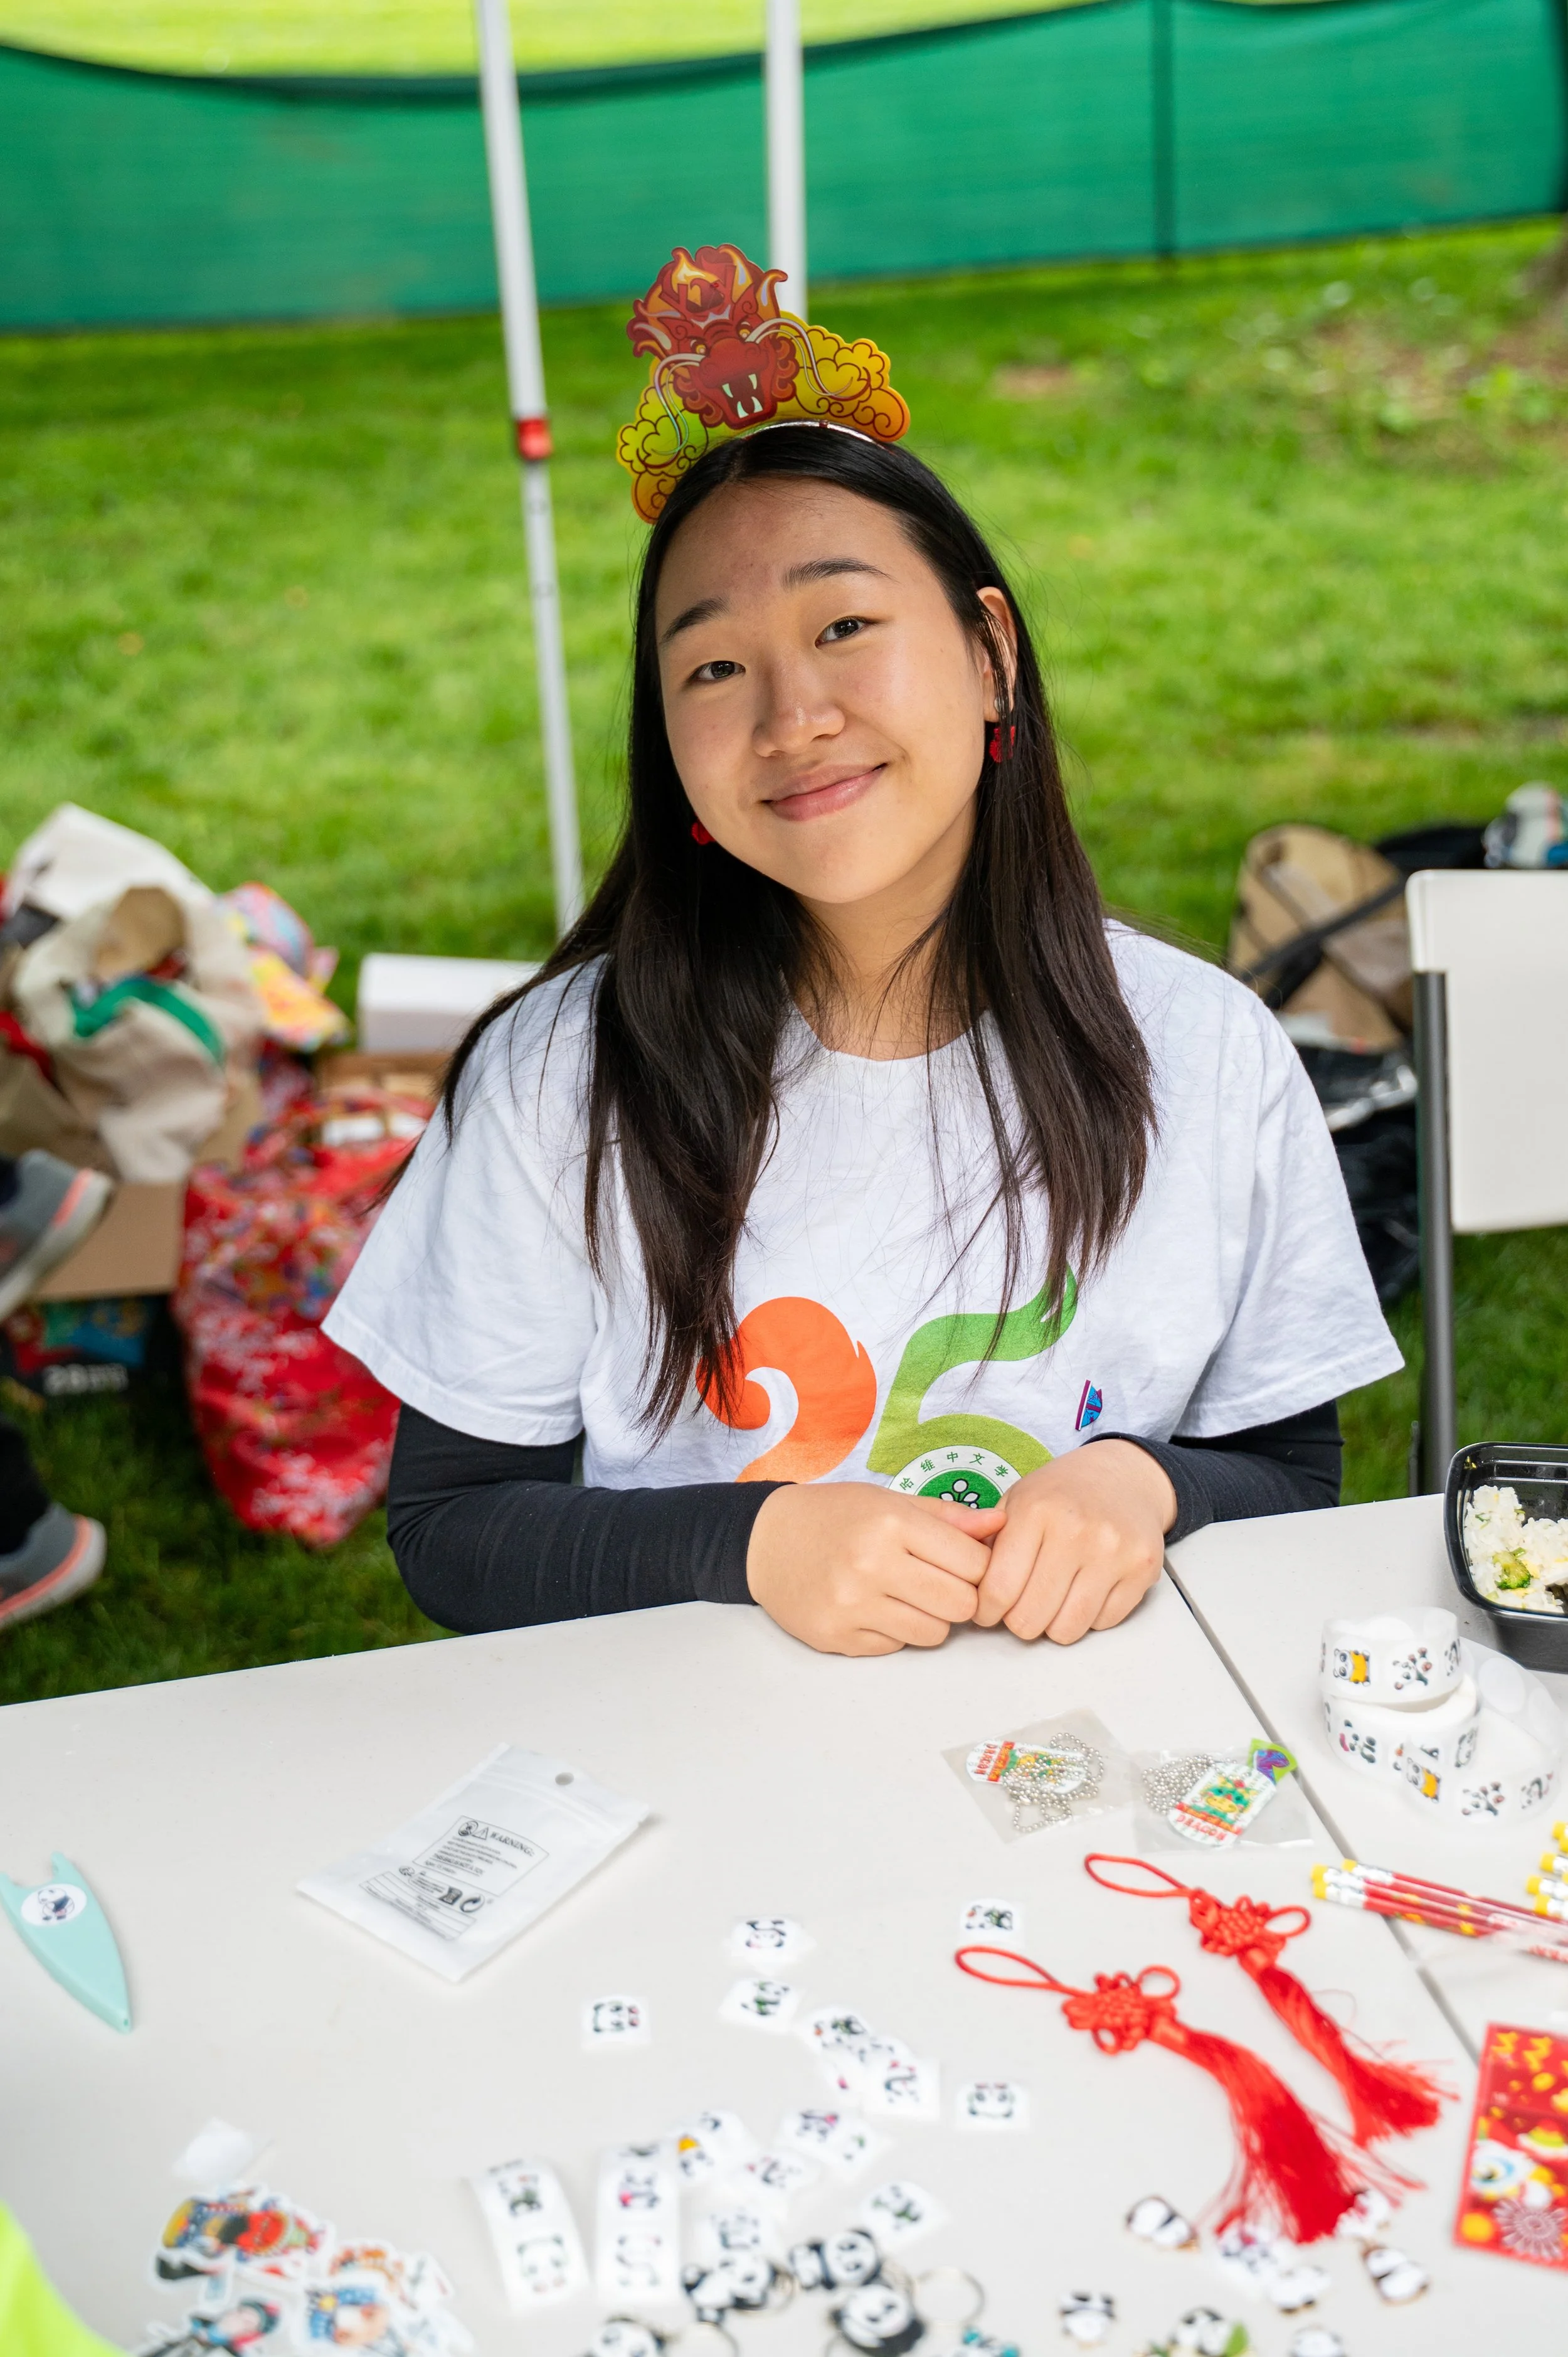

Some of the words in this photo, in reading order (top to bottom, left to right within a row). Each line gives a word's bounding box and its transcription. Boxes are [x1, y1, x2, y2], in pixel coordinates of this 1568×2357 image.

[696, 1260, 1078, 1484] 25
[899, 1451, 1009, 1491] 哈维中文学
[973, 1743, 998, 1775] DRAGON
[1175, 1814, 1227, 1841] DRAGON
[490, 1831, 535, 1857] WARNING:
